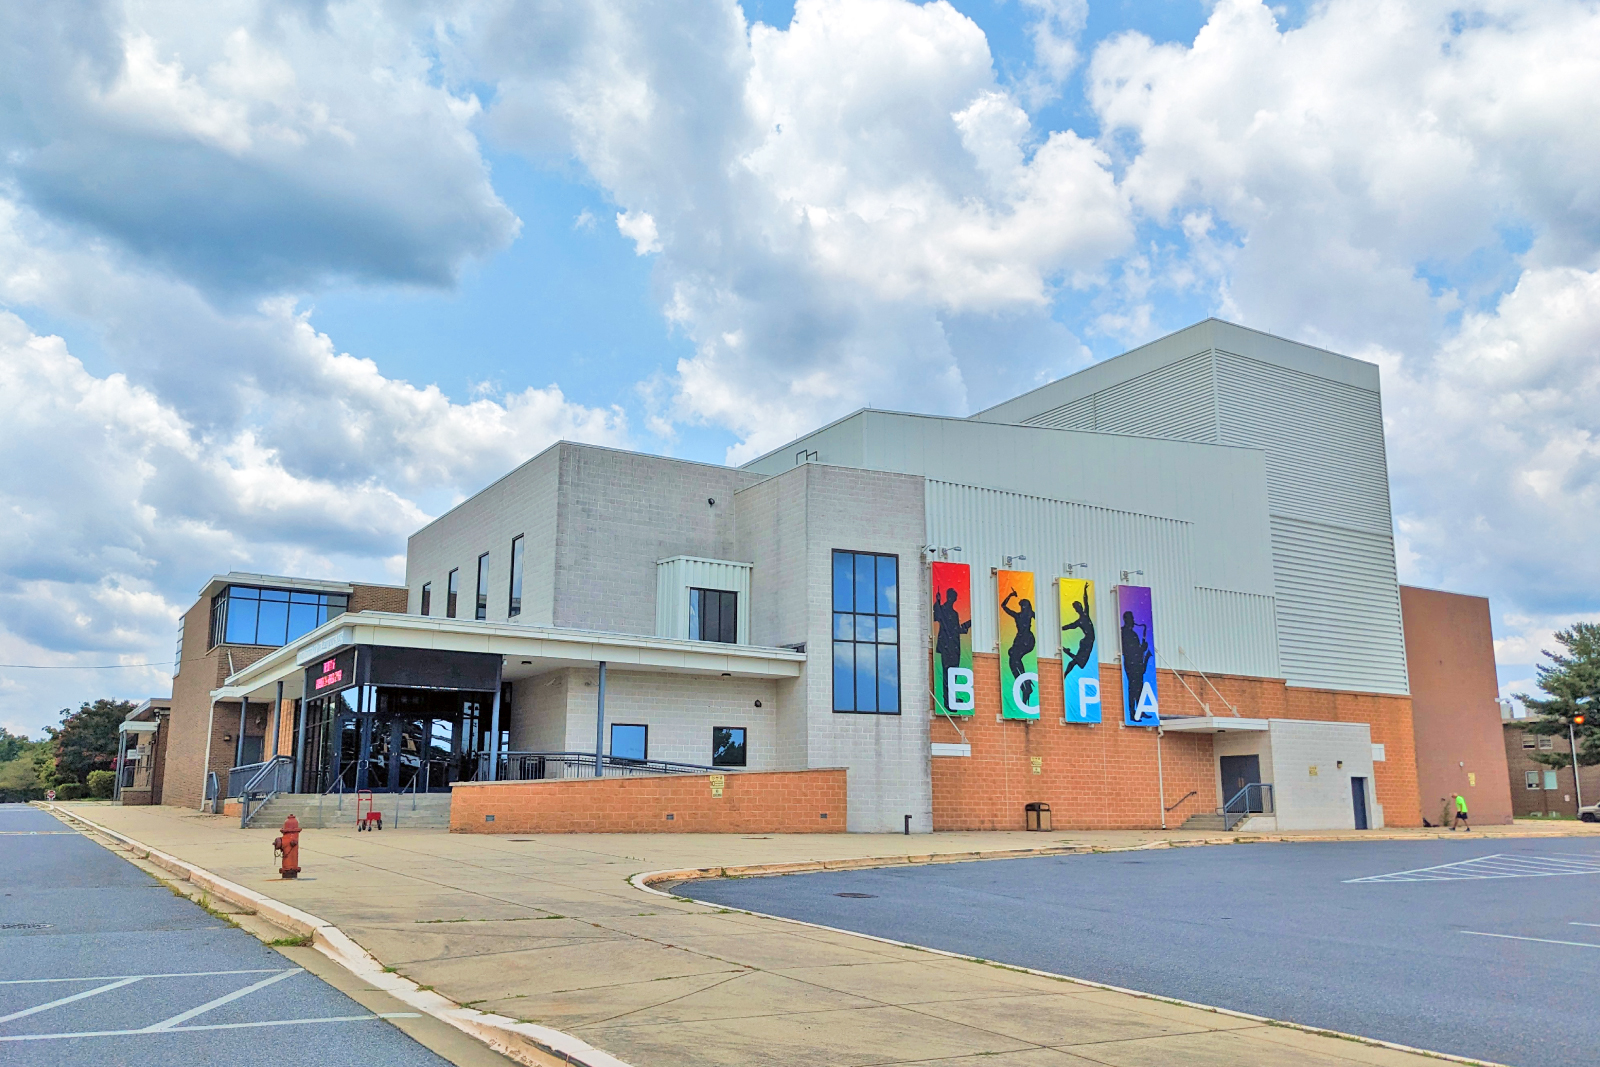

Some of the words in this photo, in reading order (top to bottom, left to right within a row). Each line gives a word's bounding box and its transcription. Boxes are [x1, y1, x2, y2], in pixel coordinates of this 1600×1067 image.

[947, 667, 974, 710] B
[1012, 672, 1040, 714] C
[1078, 677, 1100, 717] P
[1134, 681, 1160, 721] A
